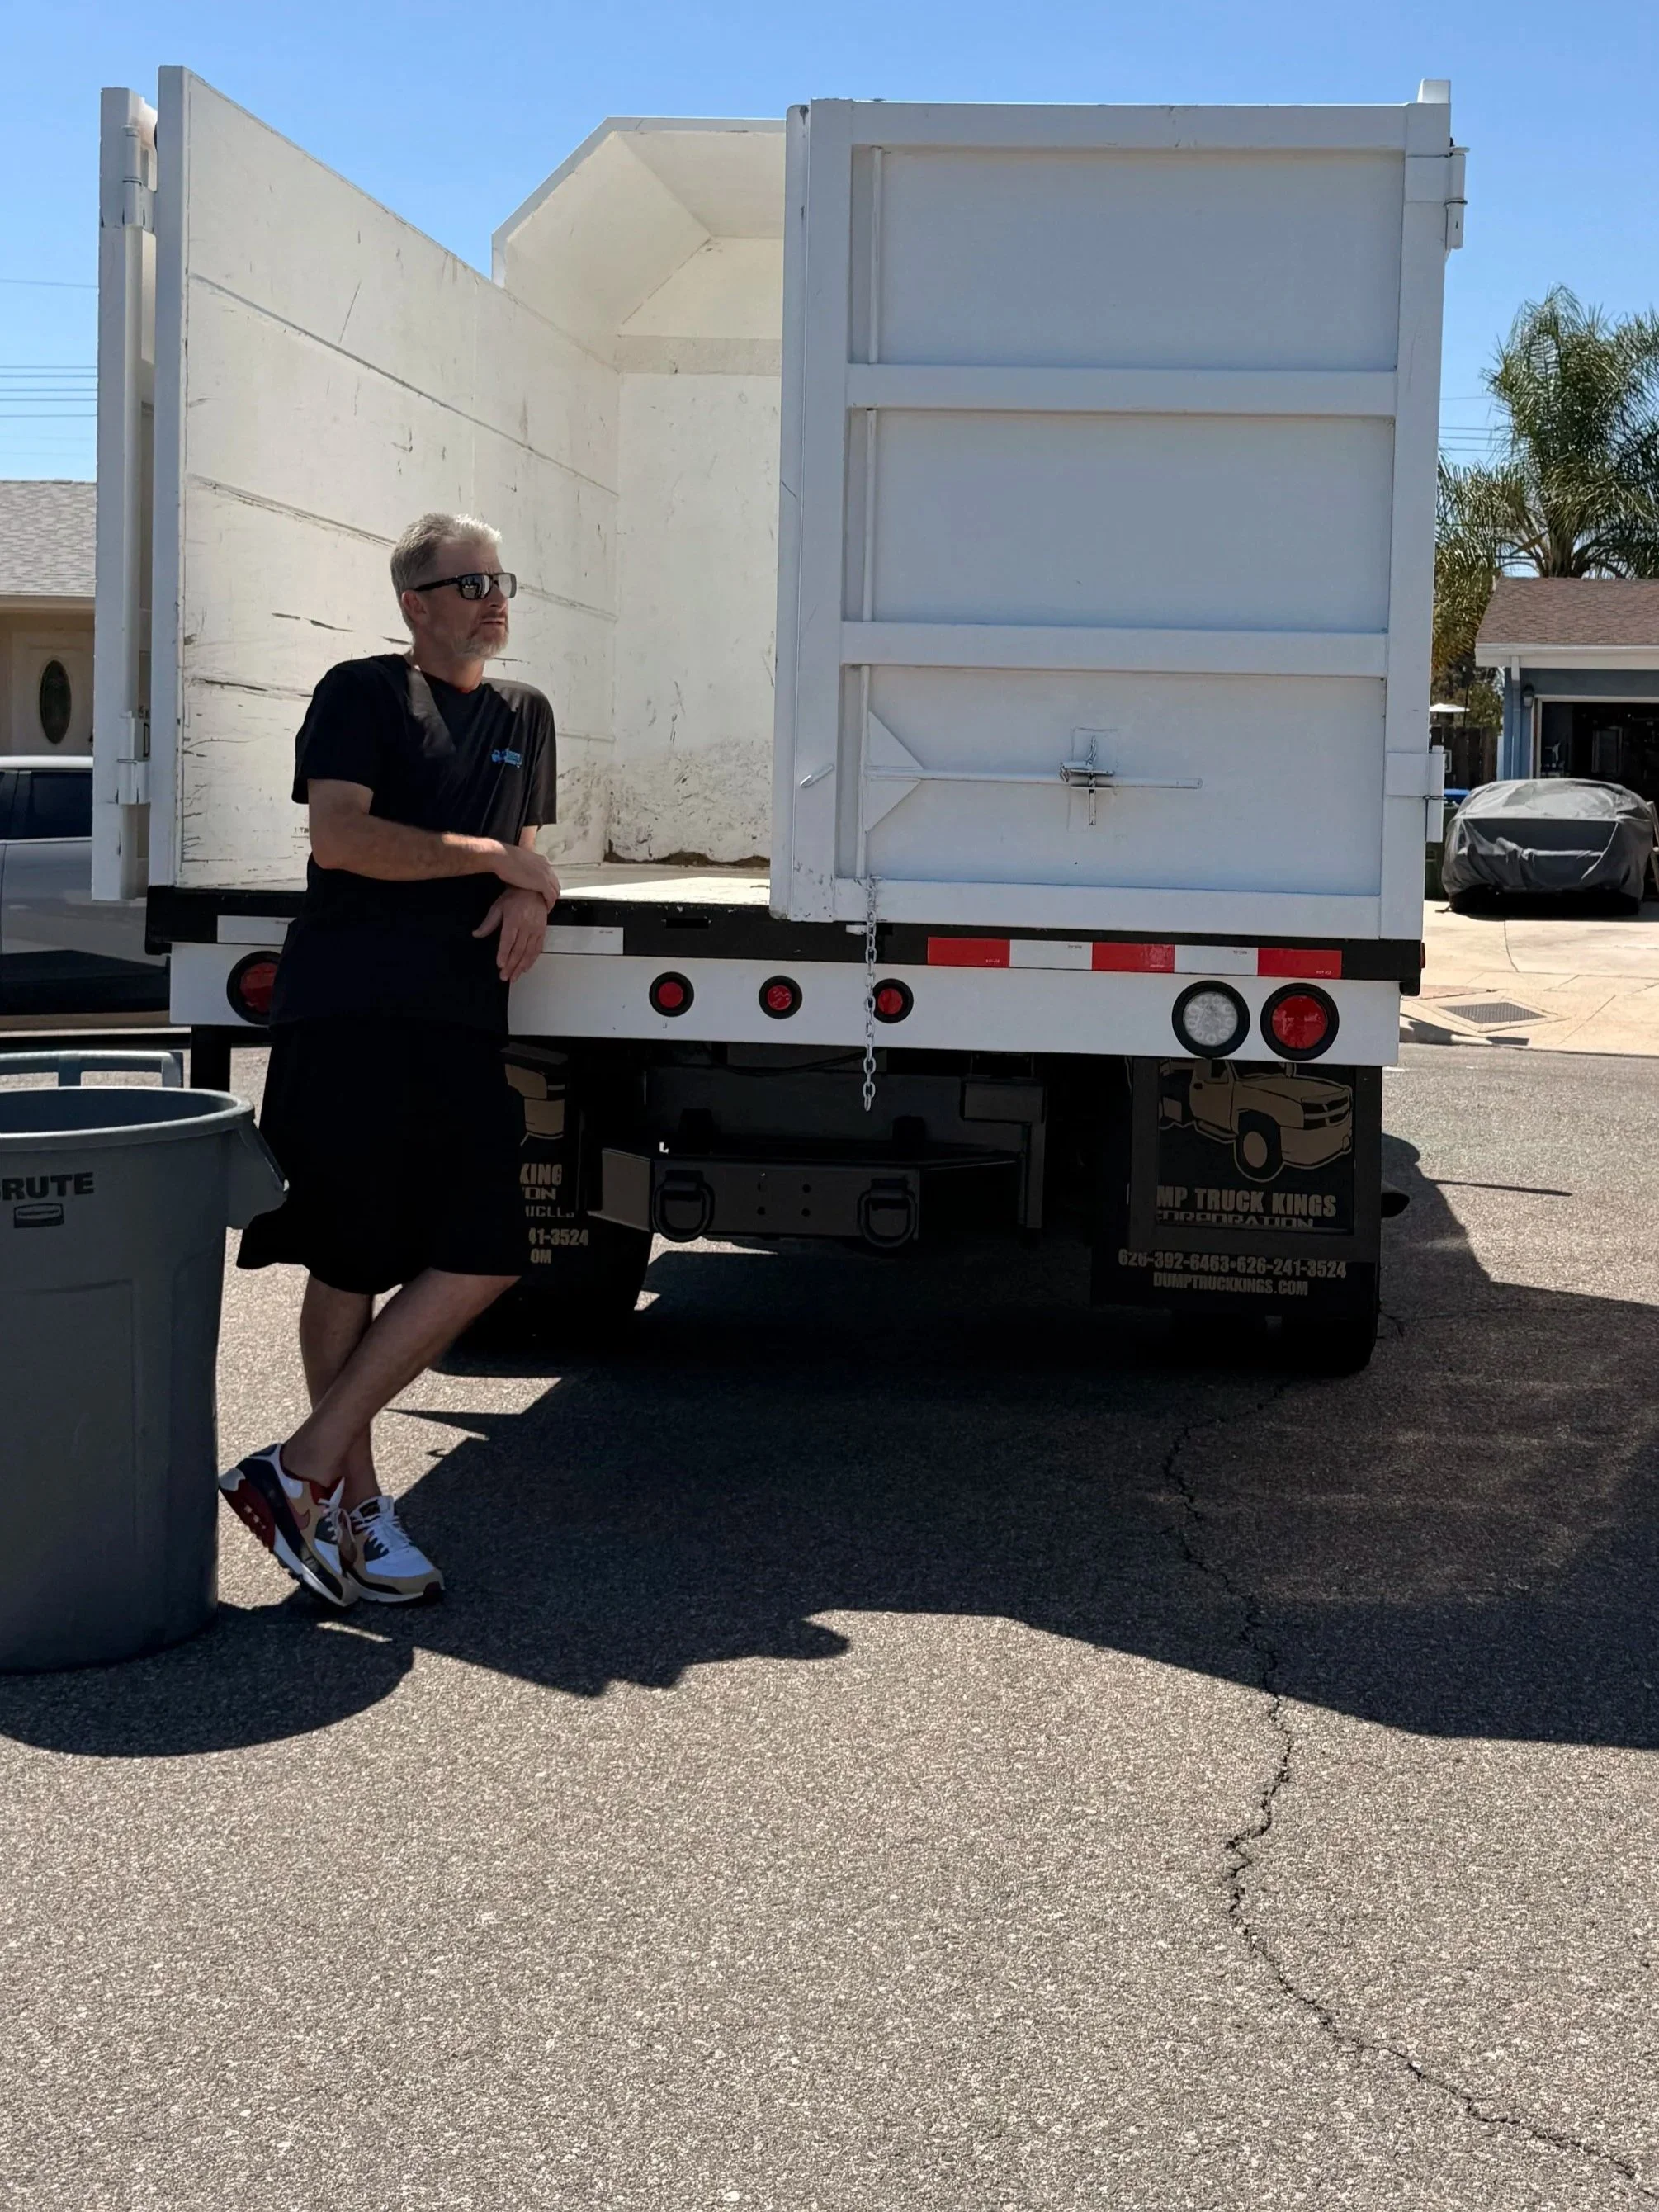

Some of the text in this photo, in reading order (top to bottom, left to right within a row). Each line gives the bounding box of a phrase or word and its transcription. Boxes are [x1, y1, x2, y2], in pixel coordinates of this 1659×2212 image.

[0, 1172, 94, 1200] RUTE
[519, 1163, 563, 1186] KING
[1156, 1185, 1337, 1217] MP TRUCK KINGS
[1153, 1272, 1309, 1297] DUMPTRUCKKINGS.COM
